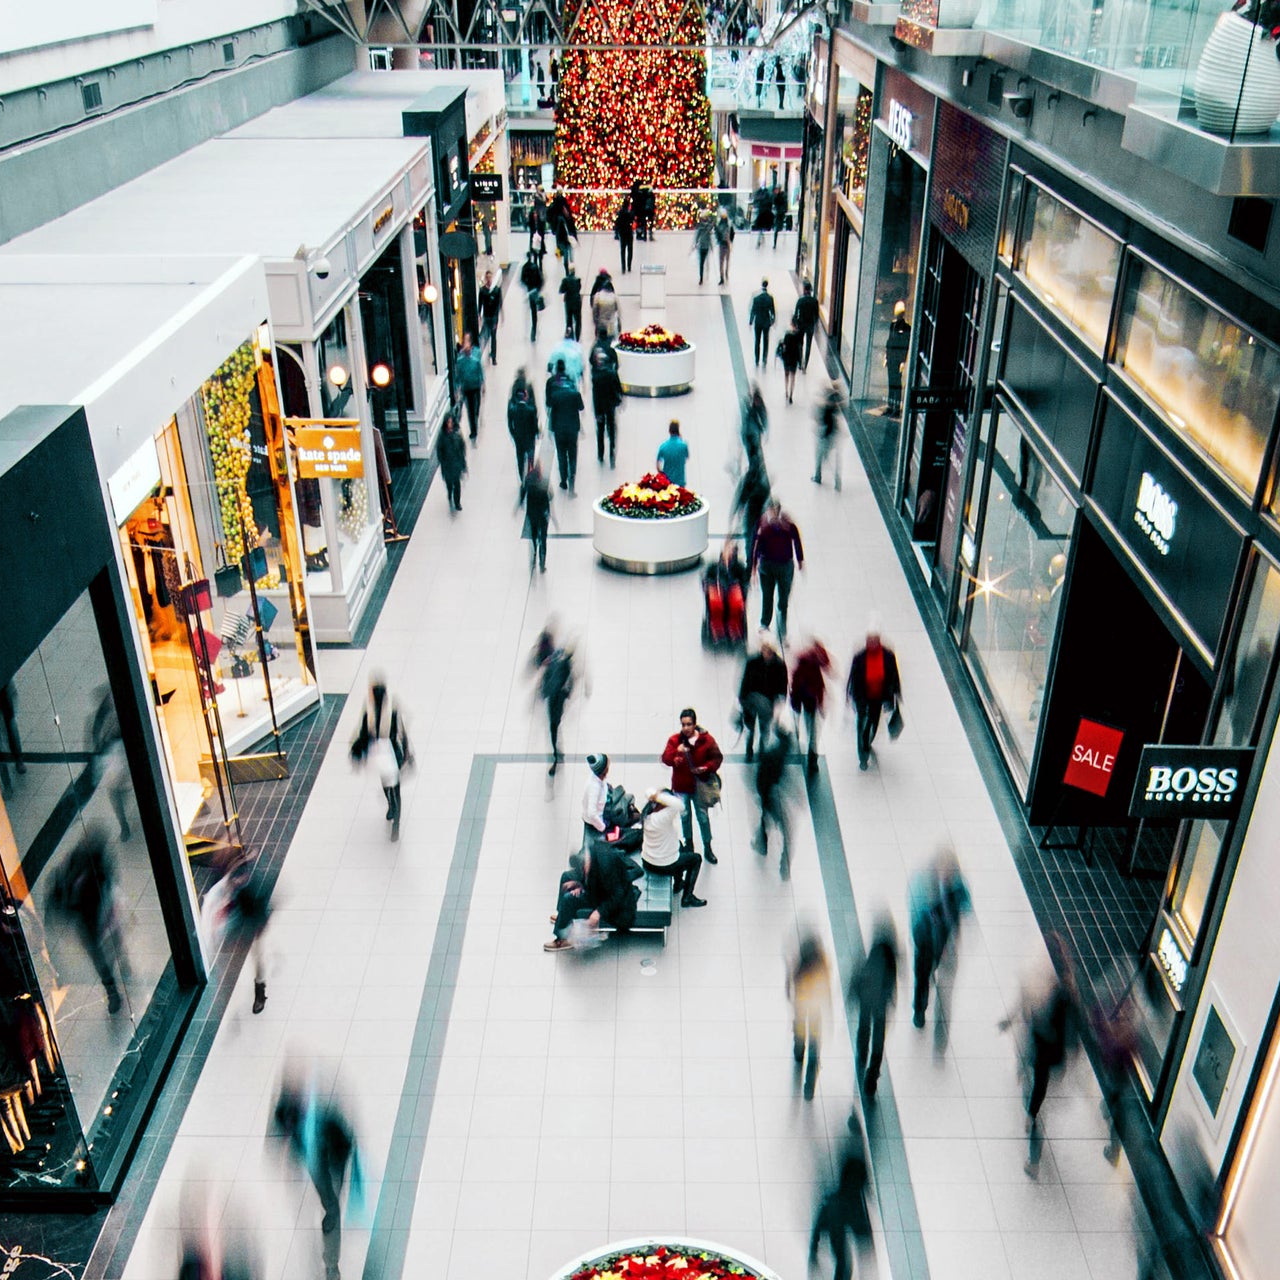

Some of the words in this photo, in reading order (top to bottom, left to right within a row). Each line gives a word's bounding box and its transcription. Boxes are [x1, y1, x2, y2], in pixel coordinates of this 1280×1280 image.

[299, 447, 325, 461] kate
[327, 449, 361, 466] spade
[1072, 745, 1115, 772] SALE
[1145, 766, 1238, 794] BOSS
